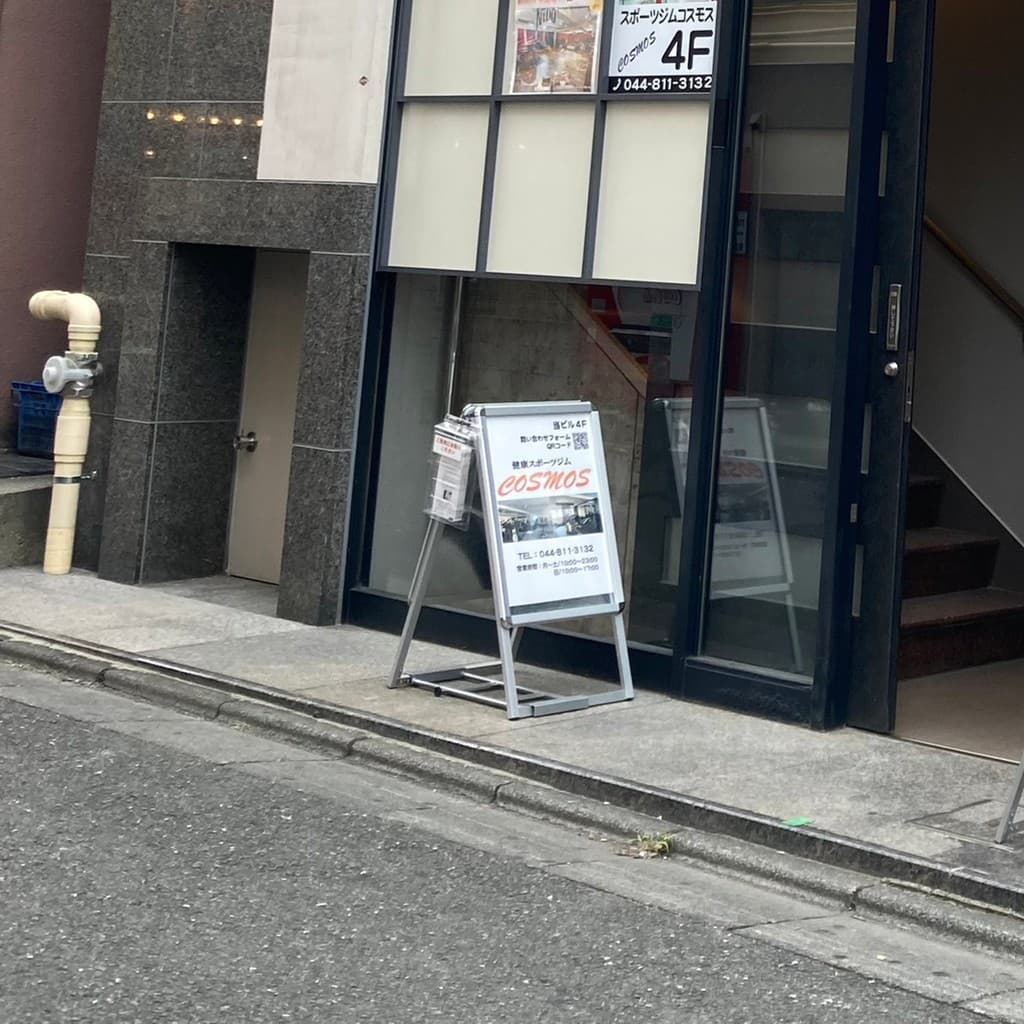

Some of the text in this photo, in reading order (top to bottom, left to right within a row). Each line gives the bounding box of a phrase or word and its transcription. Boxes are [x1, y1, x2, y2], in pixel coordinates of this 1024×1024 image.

[620, 7, 714, 25] スポーツジムコスモス
[617, 31, 657, 73] COSMOS
[661, 29, 714, 71] 4F
[623, 76, 713, 91] 044-811-3132
[498, 468, 592, 497] COSMOS
